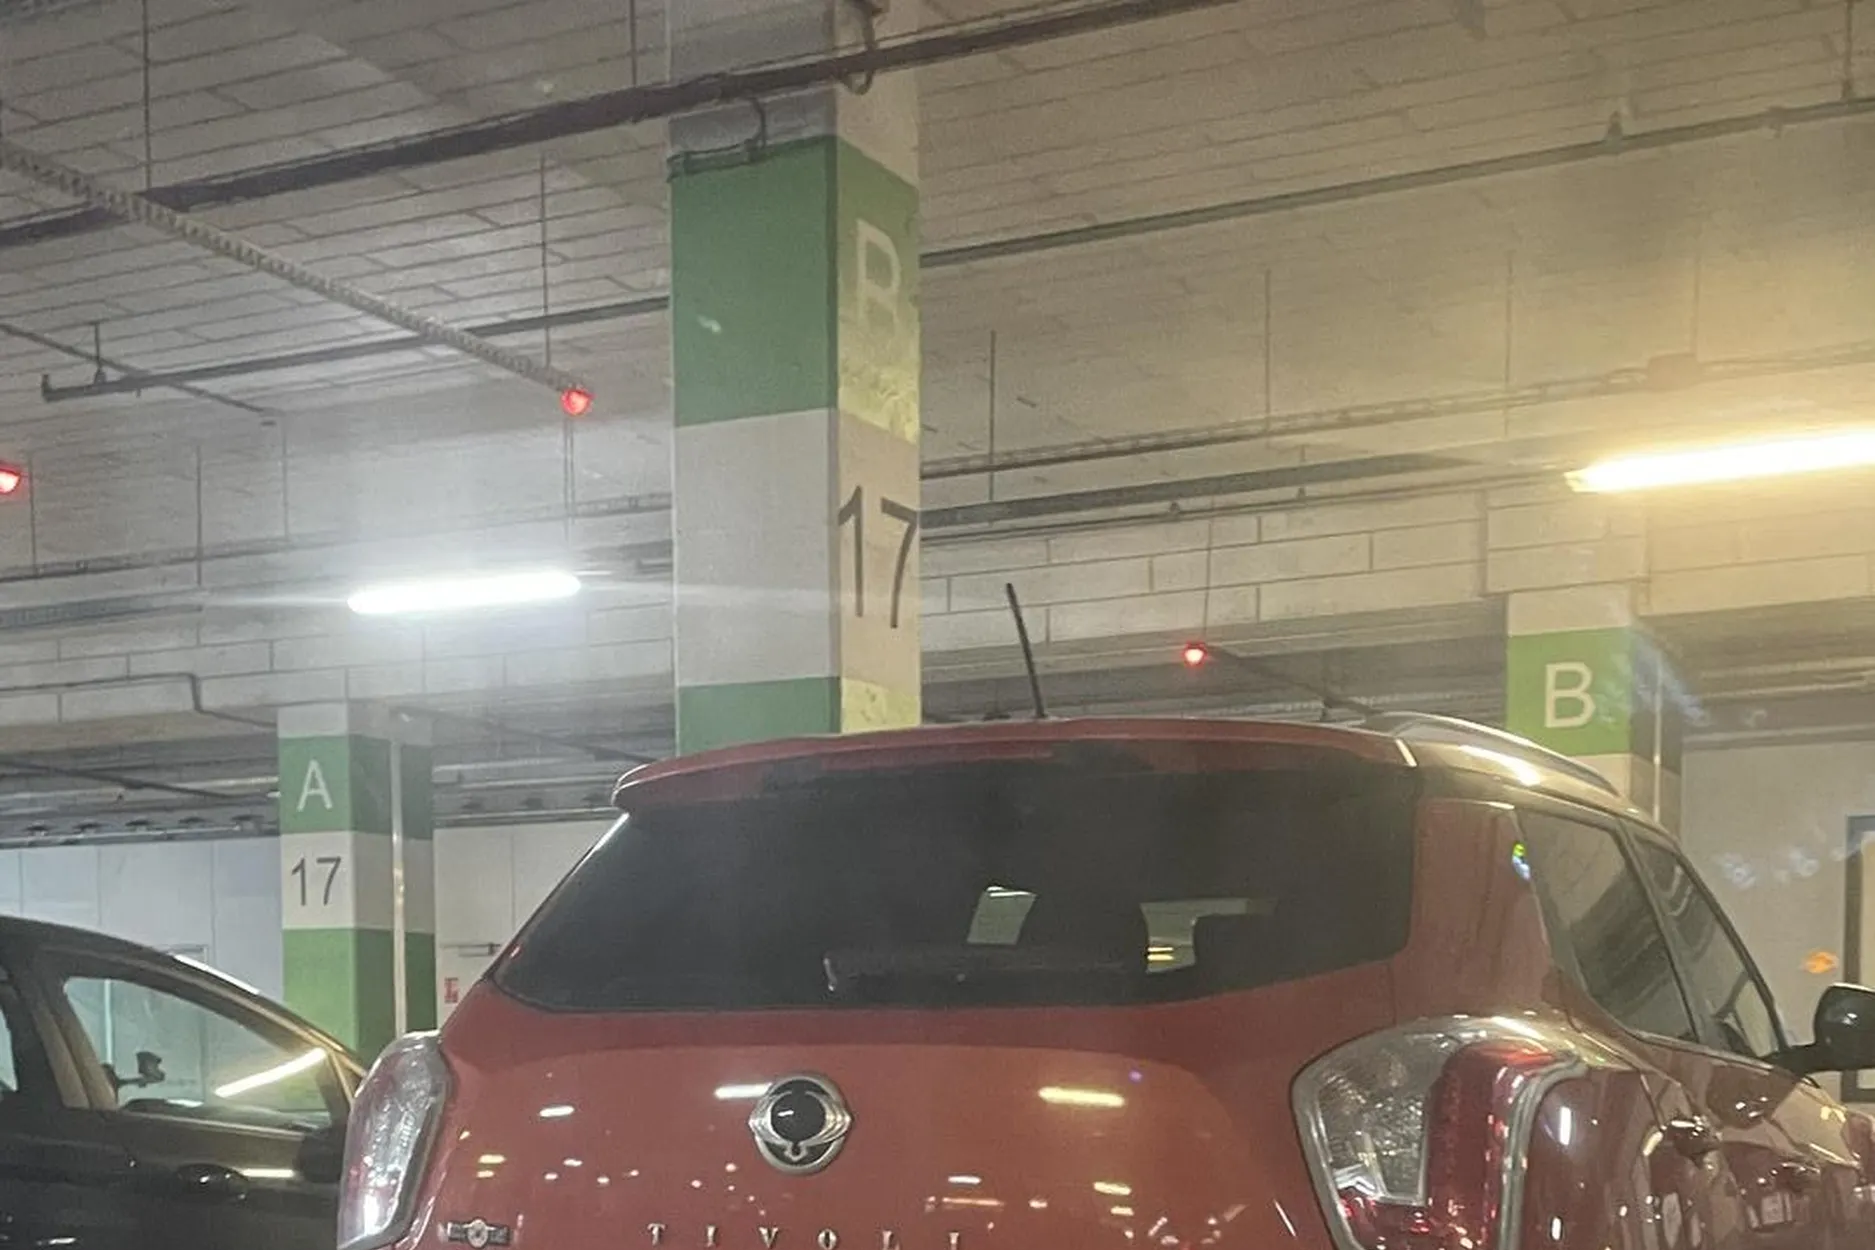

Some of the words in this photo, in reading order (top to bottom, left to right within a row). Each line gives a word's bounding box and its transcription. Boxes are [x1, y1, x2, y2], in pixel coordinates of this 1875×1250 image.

[856, 217, 901, 336] B
[838, 485, 918, 629] 17
[1543, 661, 1596, 729] B
[297, 760, 333, 811] A
[290, 856, 342, 906] 17
